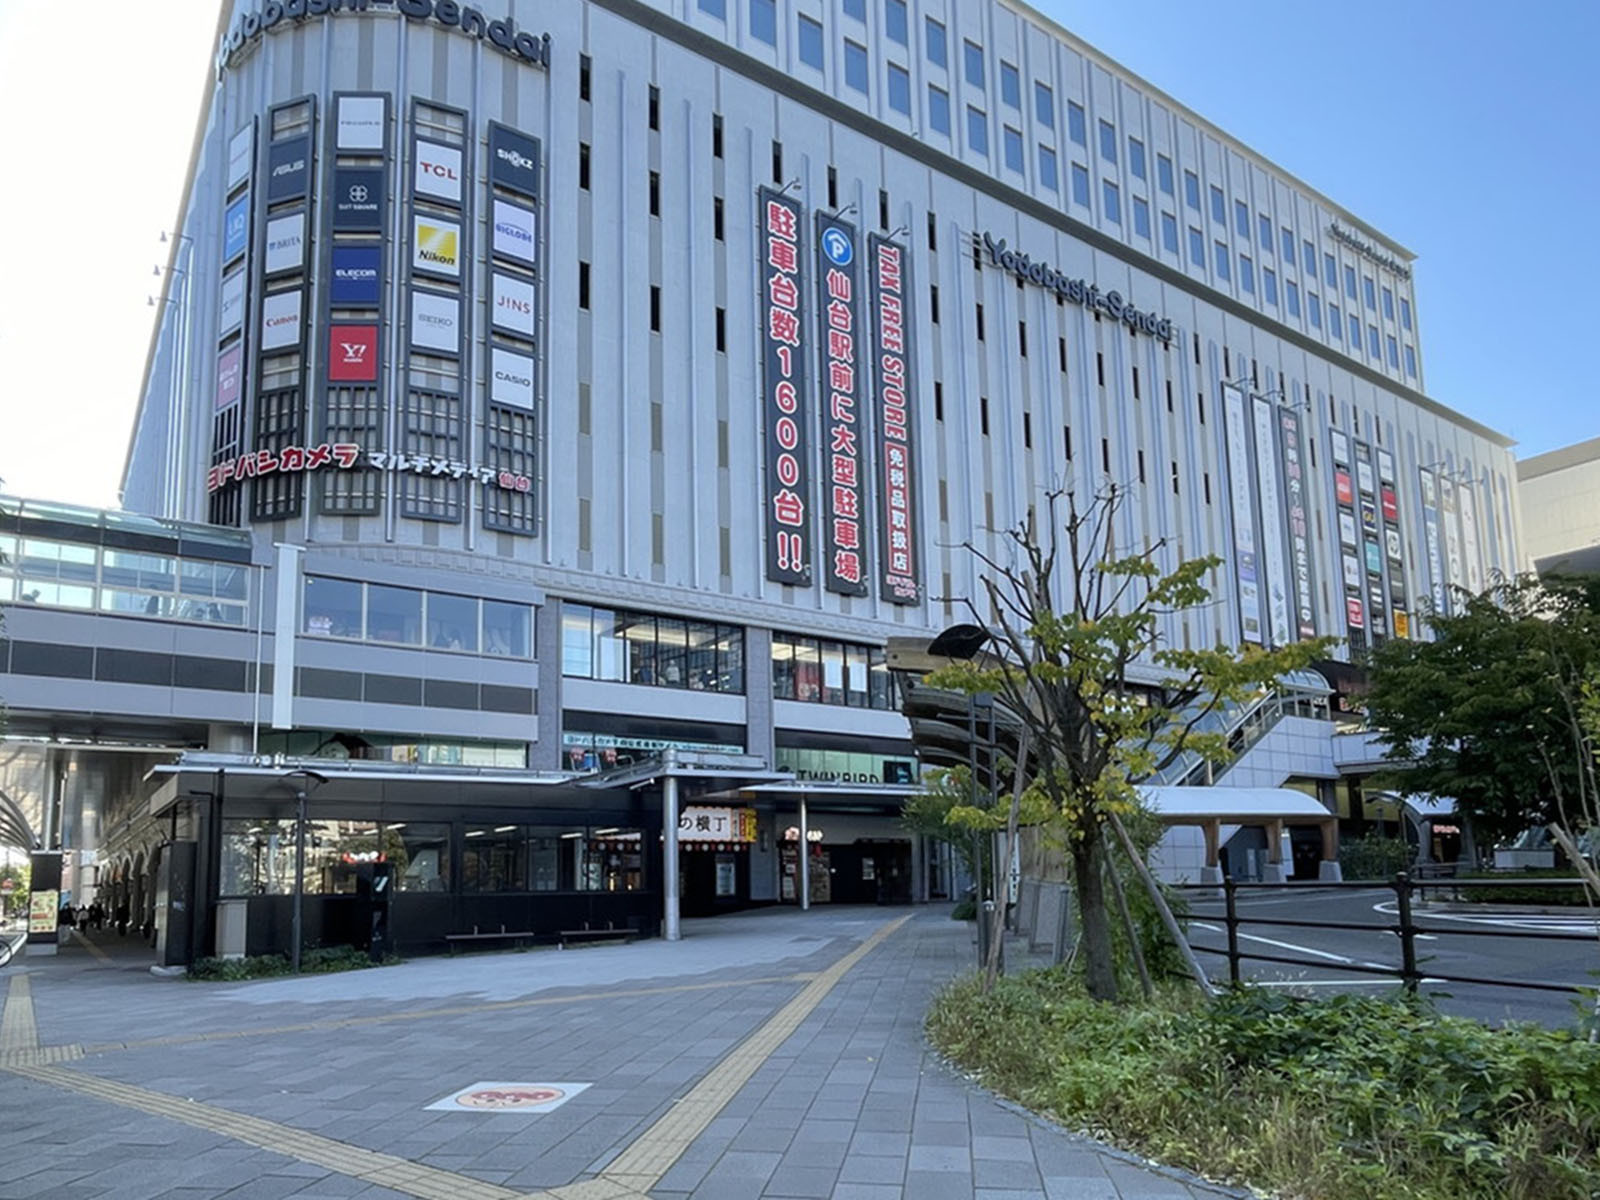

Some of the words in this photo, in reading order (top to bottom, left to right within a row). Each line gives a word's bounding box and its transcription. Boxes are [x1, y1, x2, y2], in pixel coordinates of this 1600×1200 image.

[420, 161, 458, 180] TCL
[418, 249, 456, 266] Nikon
[335, 269, 377, 277] ELECOM
[878, 244, 901, 293] TAX
[497, 296, 531, 315] JINS
[265, 315, 299, 328] Canon
[418, 314, 453, 327] SEIKO
[880, 292, 904, 354] FREE
[495, 371, 531, 387] CASIO
[882, 354, 907, 441] STORE
[826, 268, 860, 583] 仙台駅前に大型駐車場
[207, 443, 359, 493] ヨドバシカメラ
